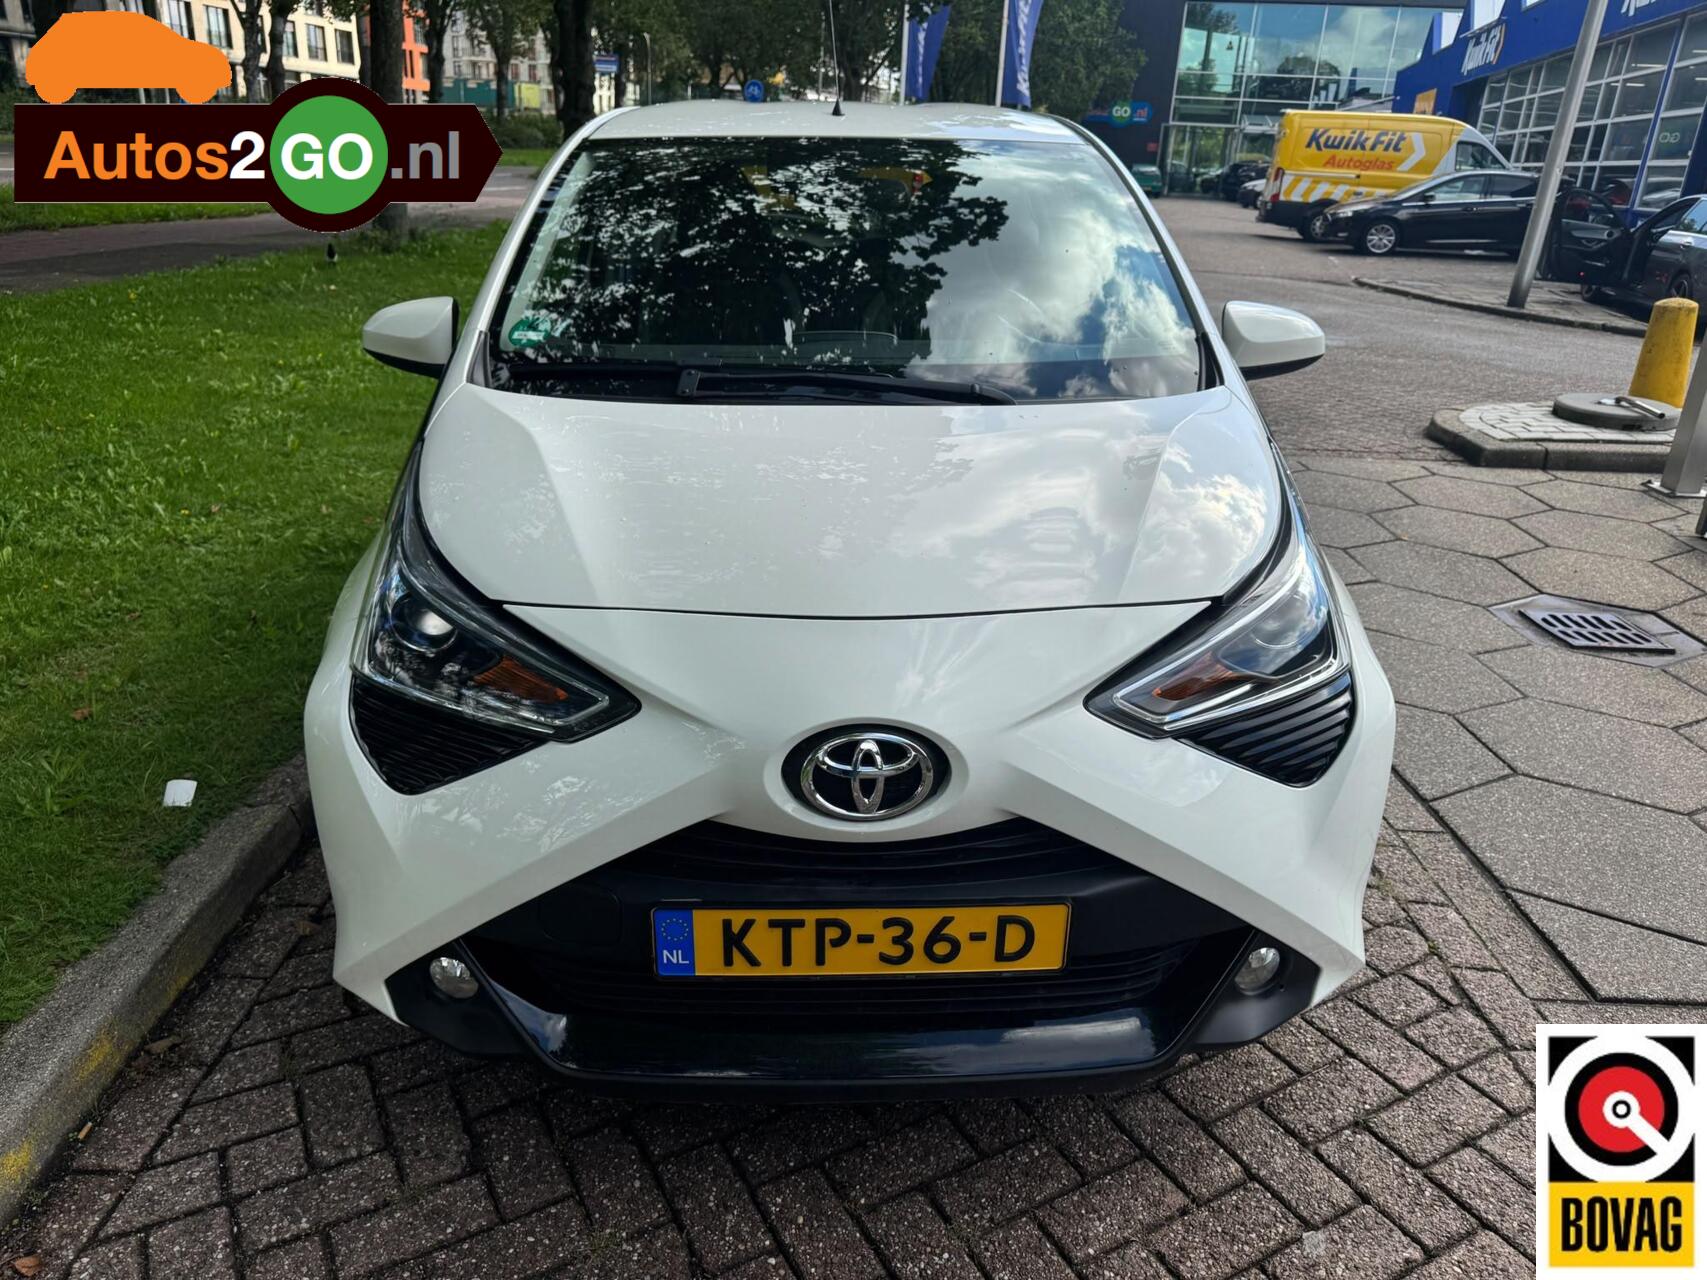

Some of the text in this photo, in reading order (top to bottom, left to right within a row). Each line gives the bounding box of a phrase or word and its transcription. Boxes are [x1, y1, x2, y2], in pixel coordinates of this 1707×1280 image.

[1323, 154, 1394, 171] Autoglas
[722, 915, 1035, 967] KTP-36-D
[663, 949, 689, 965] NL
